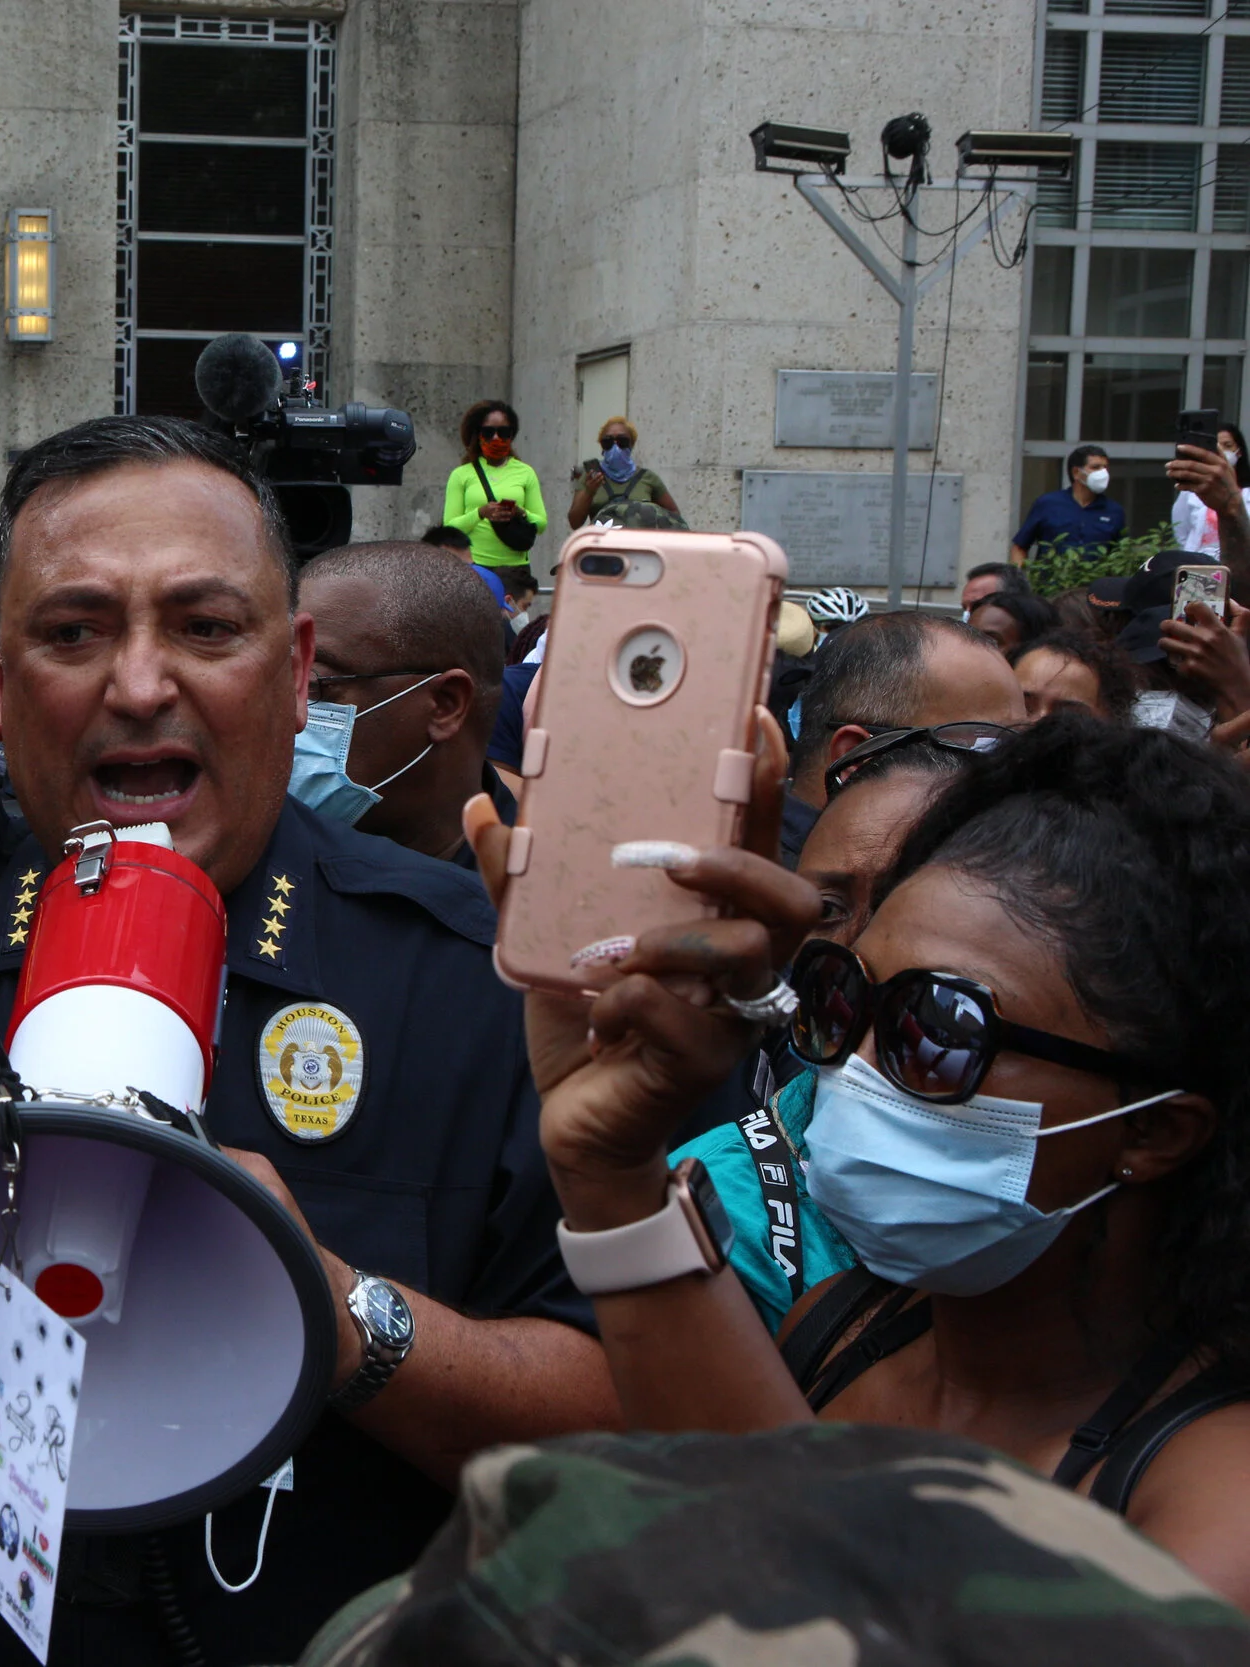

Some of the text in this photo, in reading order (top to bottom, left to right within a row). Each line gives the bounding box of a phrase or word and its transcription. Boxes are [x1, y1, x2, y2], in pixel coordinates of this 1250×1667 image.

[276, 1007, 347, 1035] HOUSTON
[280, 1087, 341, 1105] POLICE
[293, 1113, 329, 1125] TEXAS
[739, 1109, 778, 1150] FILA
[767, 1199, 797, 1279] FILA
